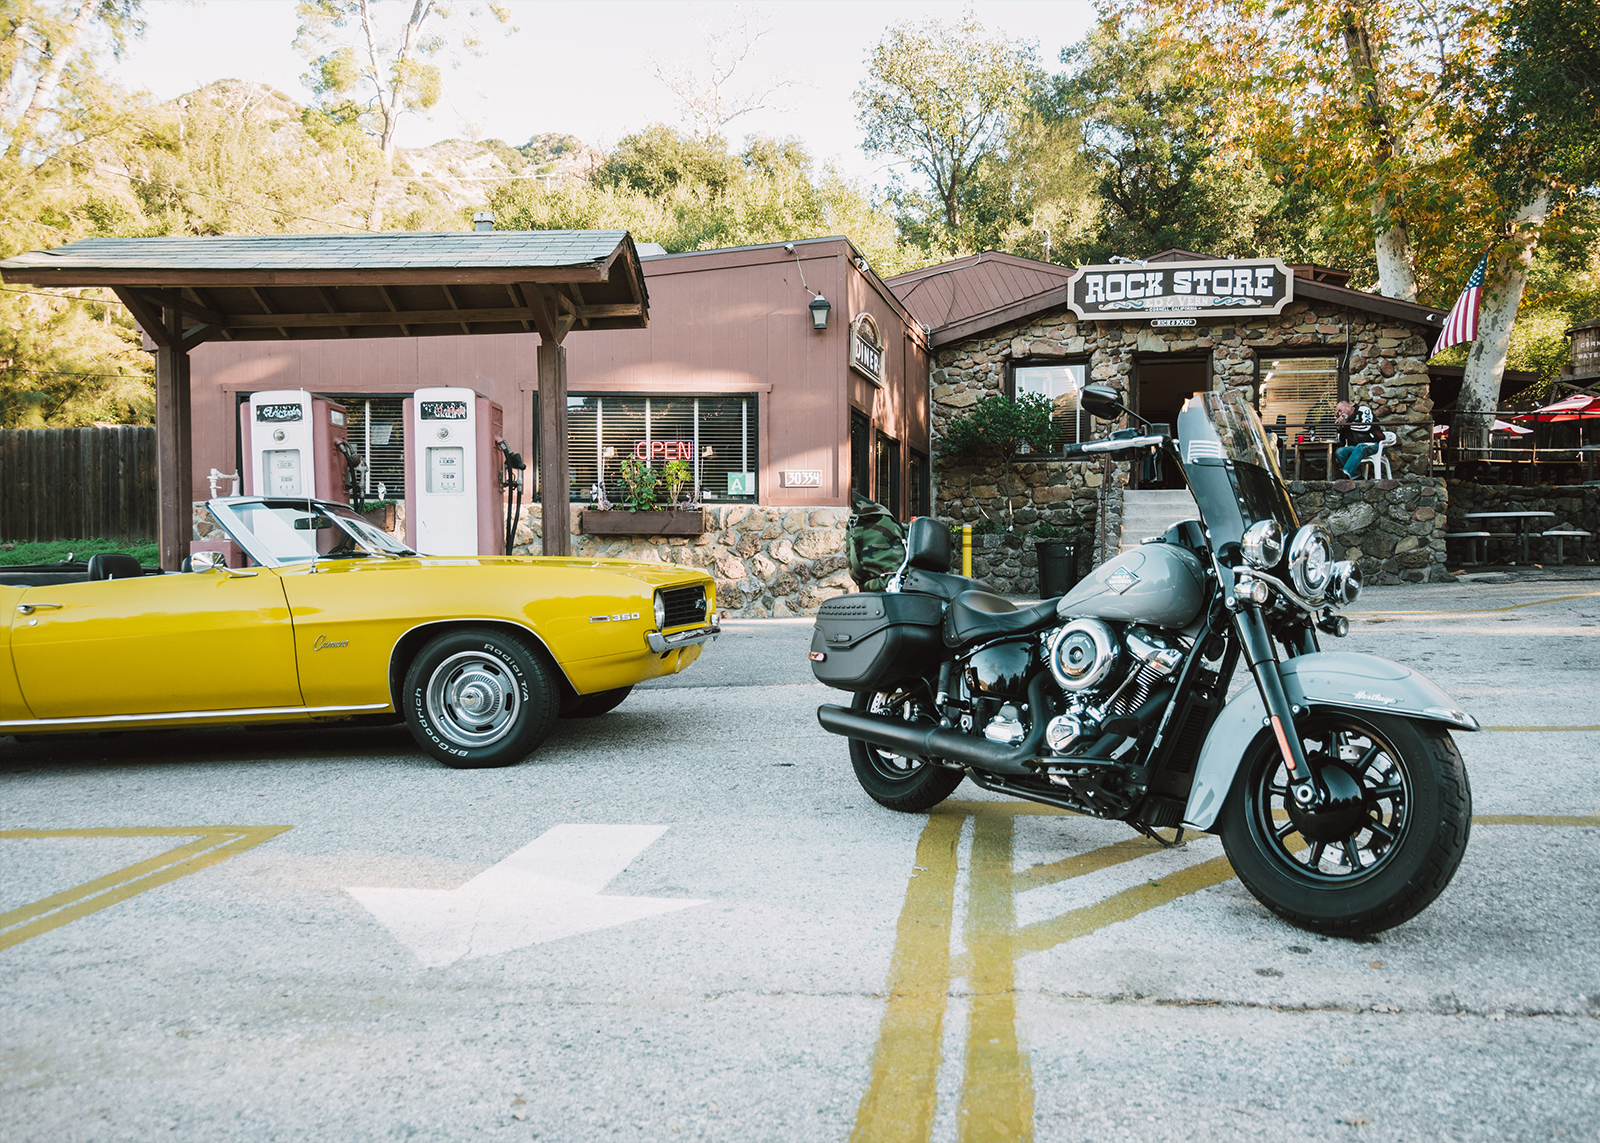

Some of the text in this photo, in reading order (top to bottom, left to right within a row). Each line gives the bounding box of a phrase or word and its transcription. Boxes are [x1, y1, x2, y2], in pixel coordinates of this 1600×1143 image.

[1085, 267, 1274, 304] ROCK STORE
[1146, 298, 1163, 307] ED
[855, 338, 879, 374] DINER
[636, 441, 692, 460] OPEN
[731, 478, 743, 490] A
[787, 472, 820, 485] 30354
[612, 612, 640, 622] 350
[313, 634, 349, 651] Camaro
[484, 643, 529, 702] Radial T/A
[1353, 691, 1398, 705] Heritage
[414, 688, 469, 757] BFGoodrich
